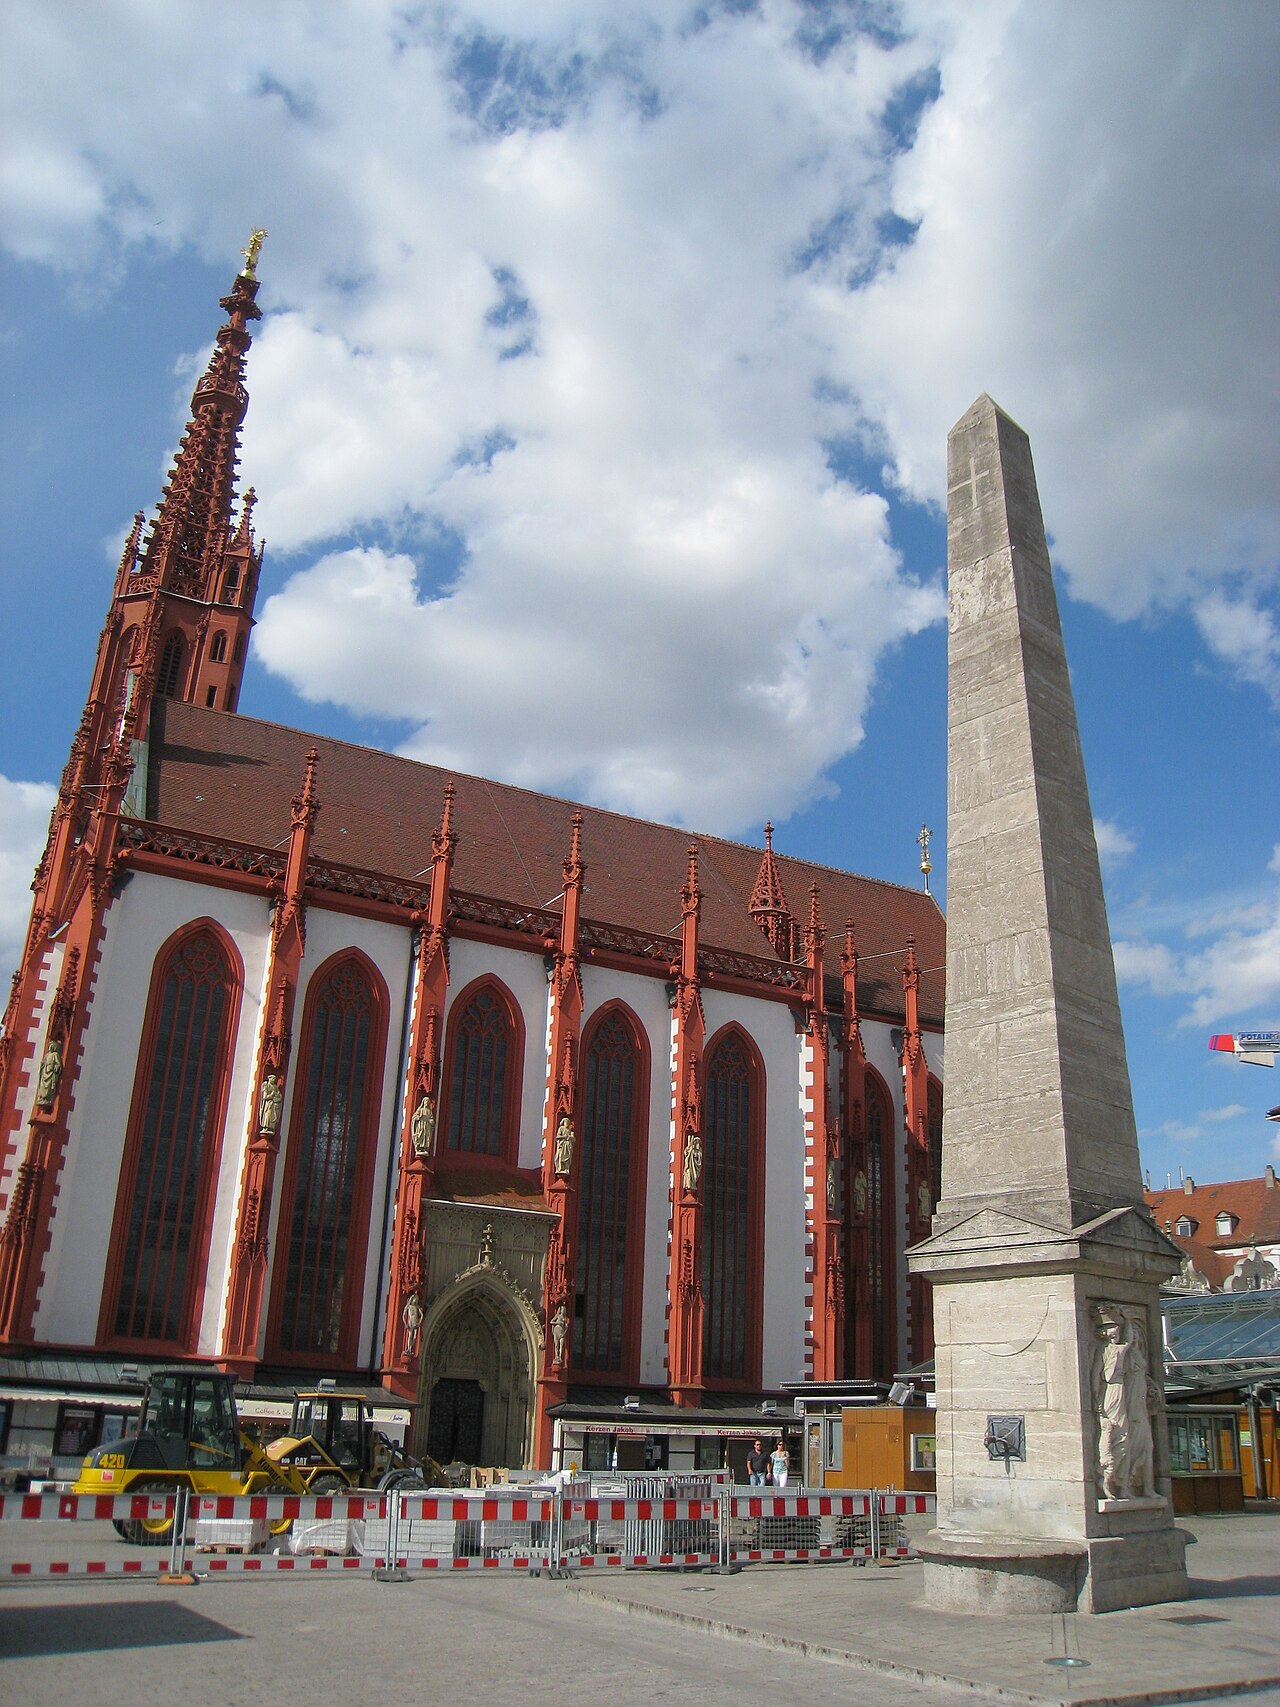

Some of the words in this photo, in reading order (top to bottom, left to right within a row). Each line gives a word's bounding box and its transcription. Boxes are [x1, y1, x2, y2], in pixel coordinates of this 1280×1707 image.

[613, 1425, 634, 1433] Jakob
[99, 1453, 125, 1469] 420
[294, 1456, 308, 1466] CAT
